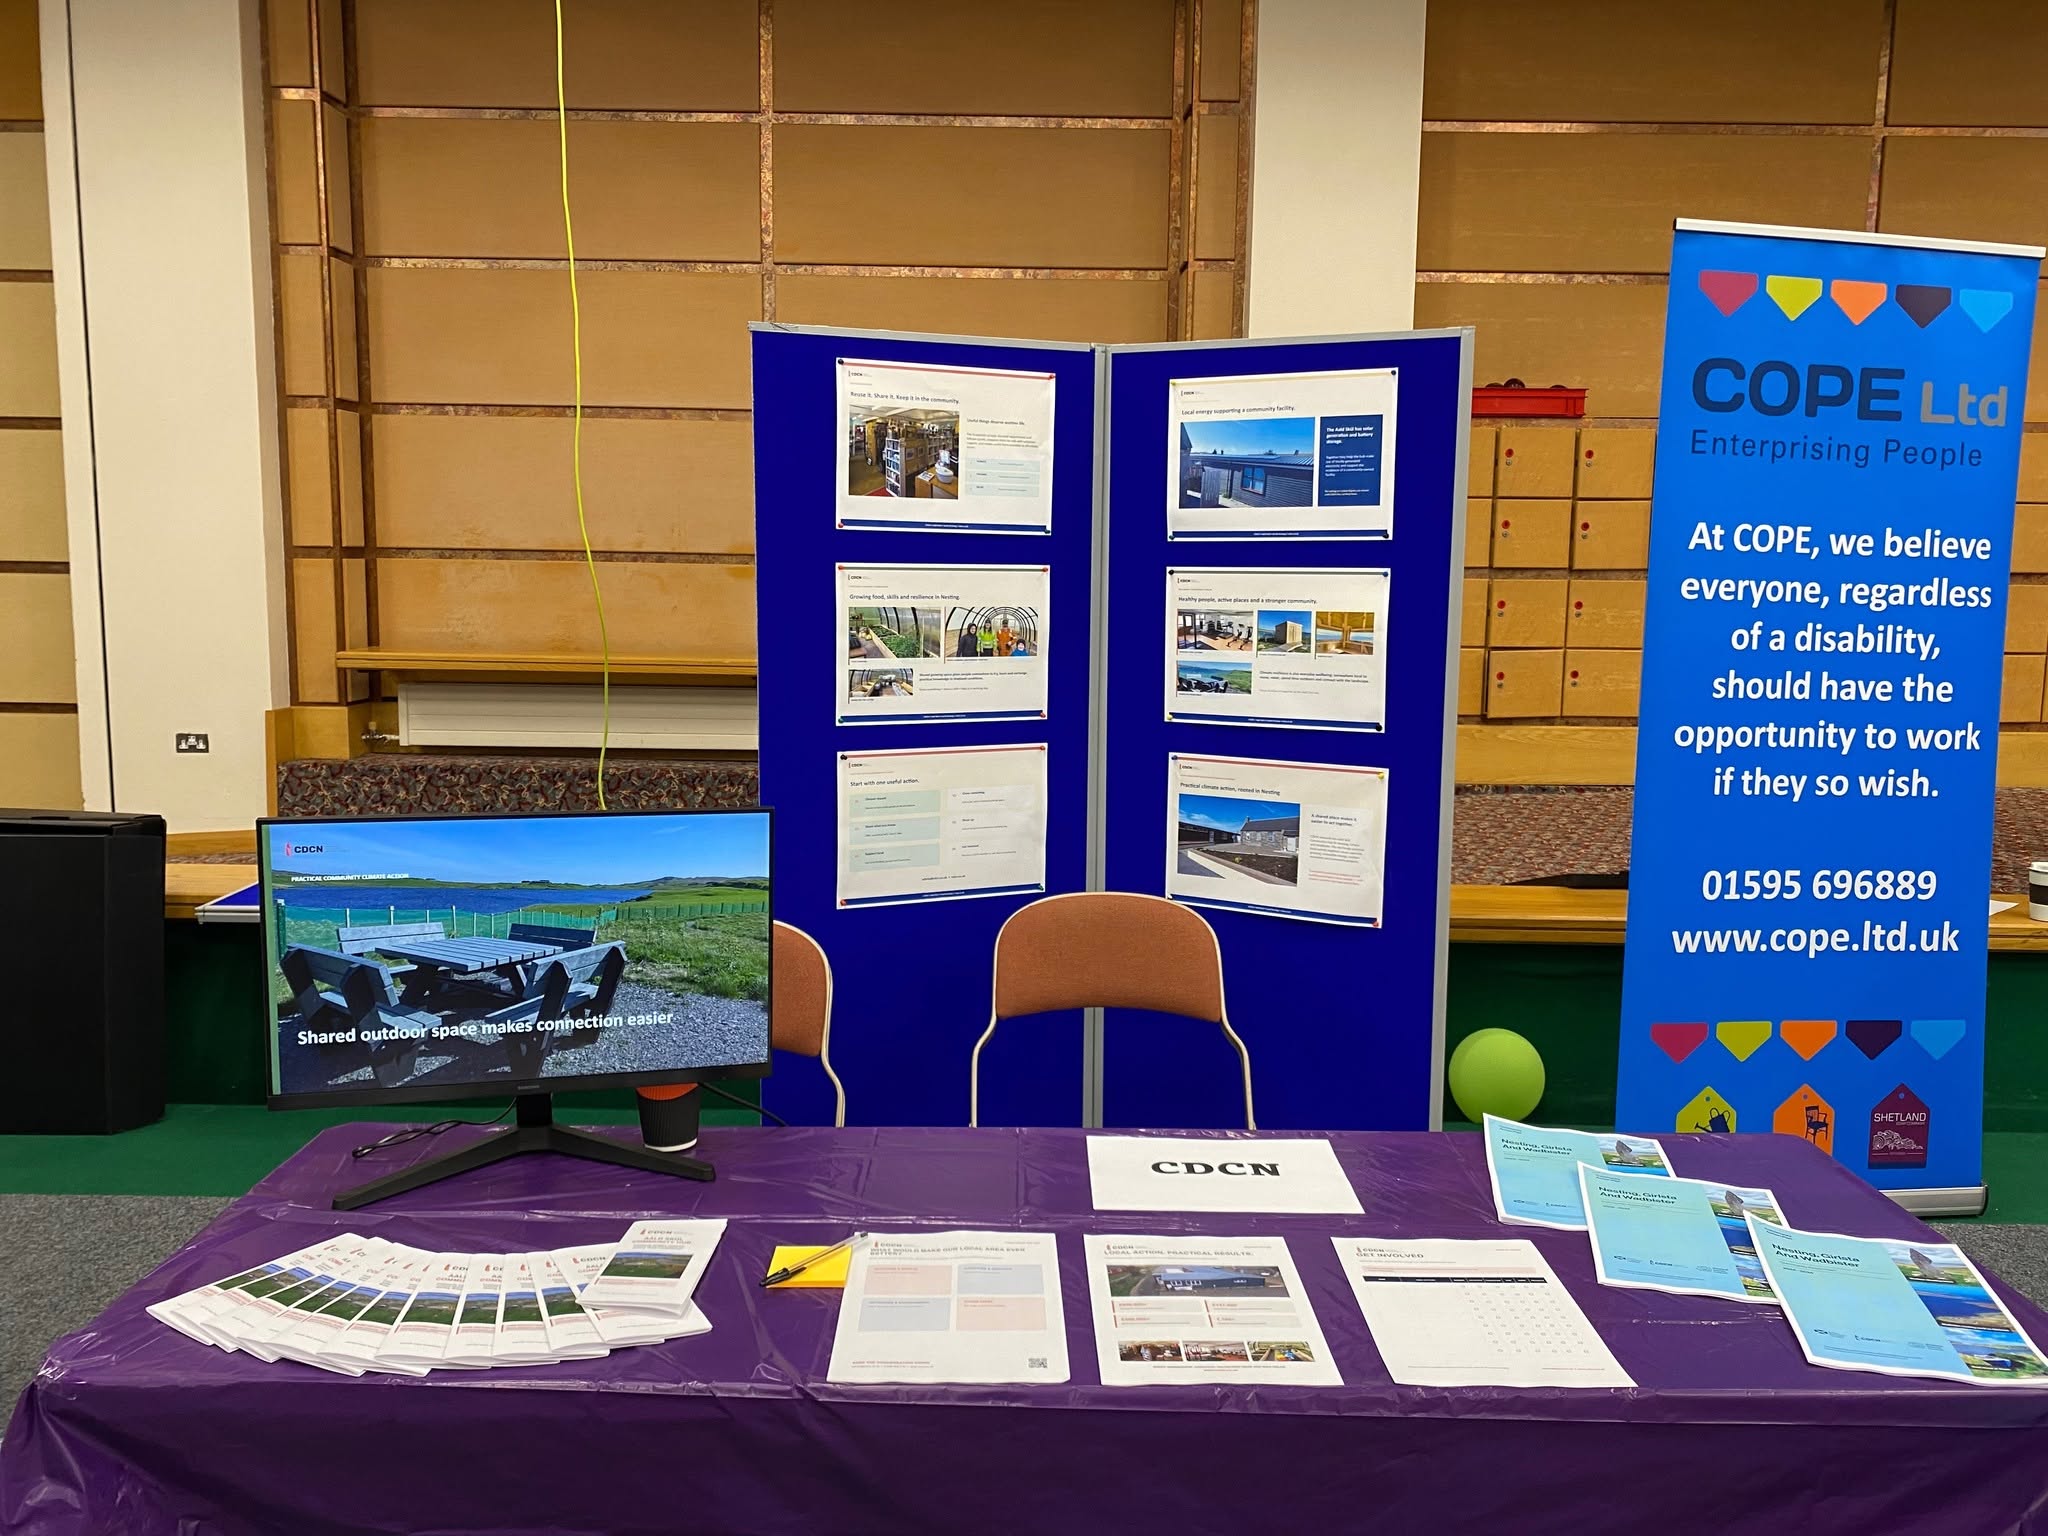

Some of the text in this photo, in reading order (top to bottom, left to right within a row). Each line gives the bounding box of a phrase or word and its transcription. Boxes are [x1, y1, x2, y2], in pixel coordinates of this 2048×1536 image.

[1692, 358, 2008, 427] COPE Ltd
[1691, 430, 1982, 470] Enterprising People
[1688, 522, 1991, 559] At COPE, we believe
[1680, 576, 1992, 611] everyone, regardless
[1731, 621, 1941, 660] of a disability,
[1712, 670, 1953, 702] should have the
[1674, 720, 1980, 755] opportunity to work
[1713, 767, 1939, 802] if they so wish.
[294, 846, 324, 854] CDCN
[1702, 869, 1937, 900] 01595 696889
[1671, 921, 1960, 958] www.cope.ltd.uk
[297, 1011, 674, 1045] Shared outdoor space makes connection easier
[1874, 1112, 1926, 1122] SHETLAND
[1151, 1161, 1280, 1176] CDCN
[1776, 1250, 1860, 1268] And Wadbister
[1820, 1253, 1860, 1262] Girlsta
